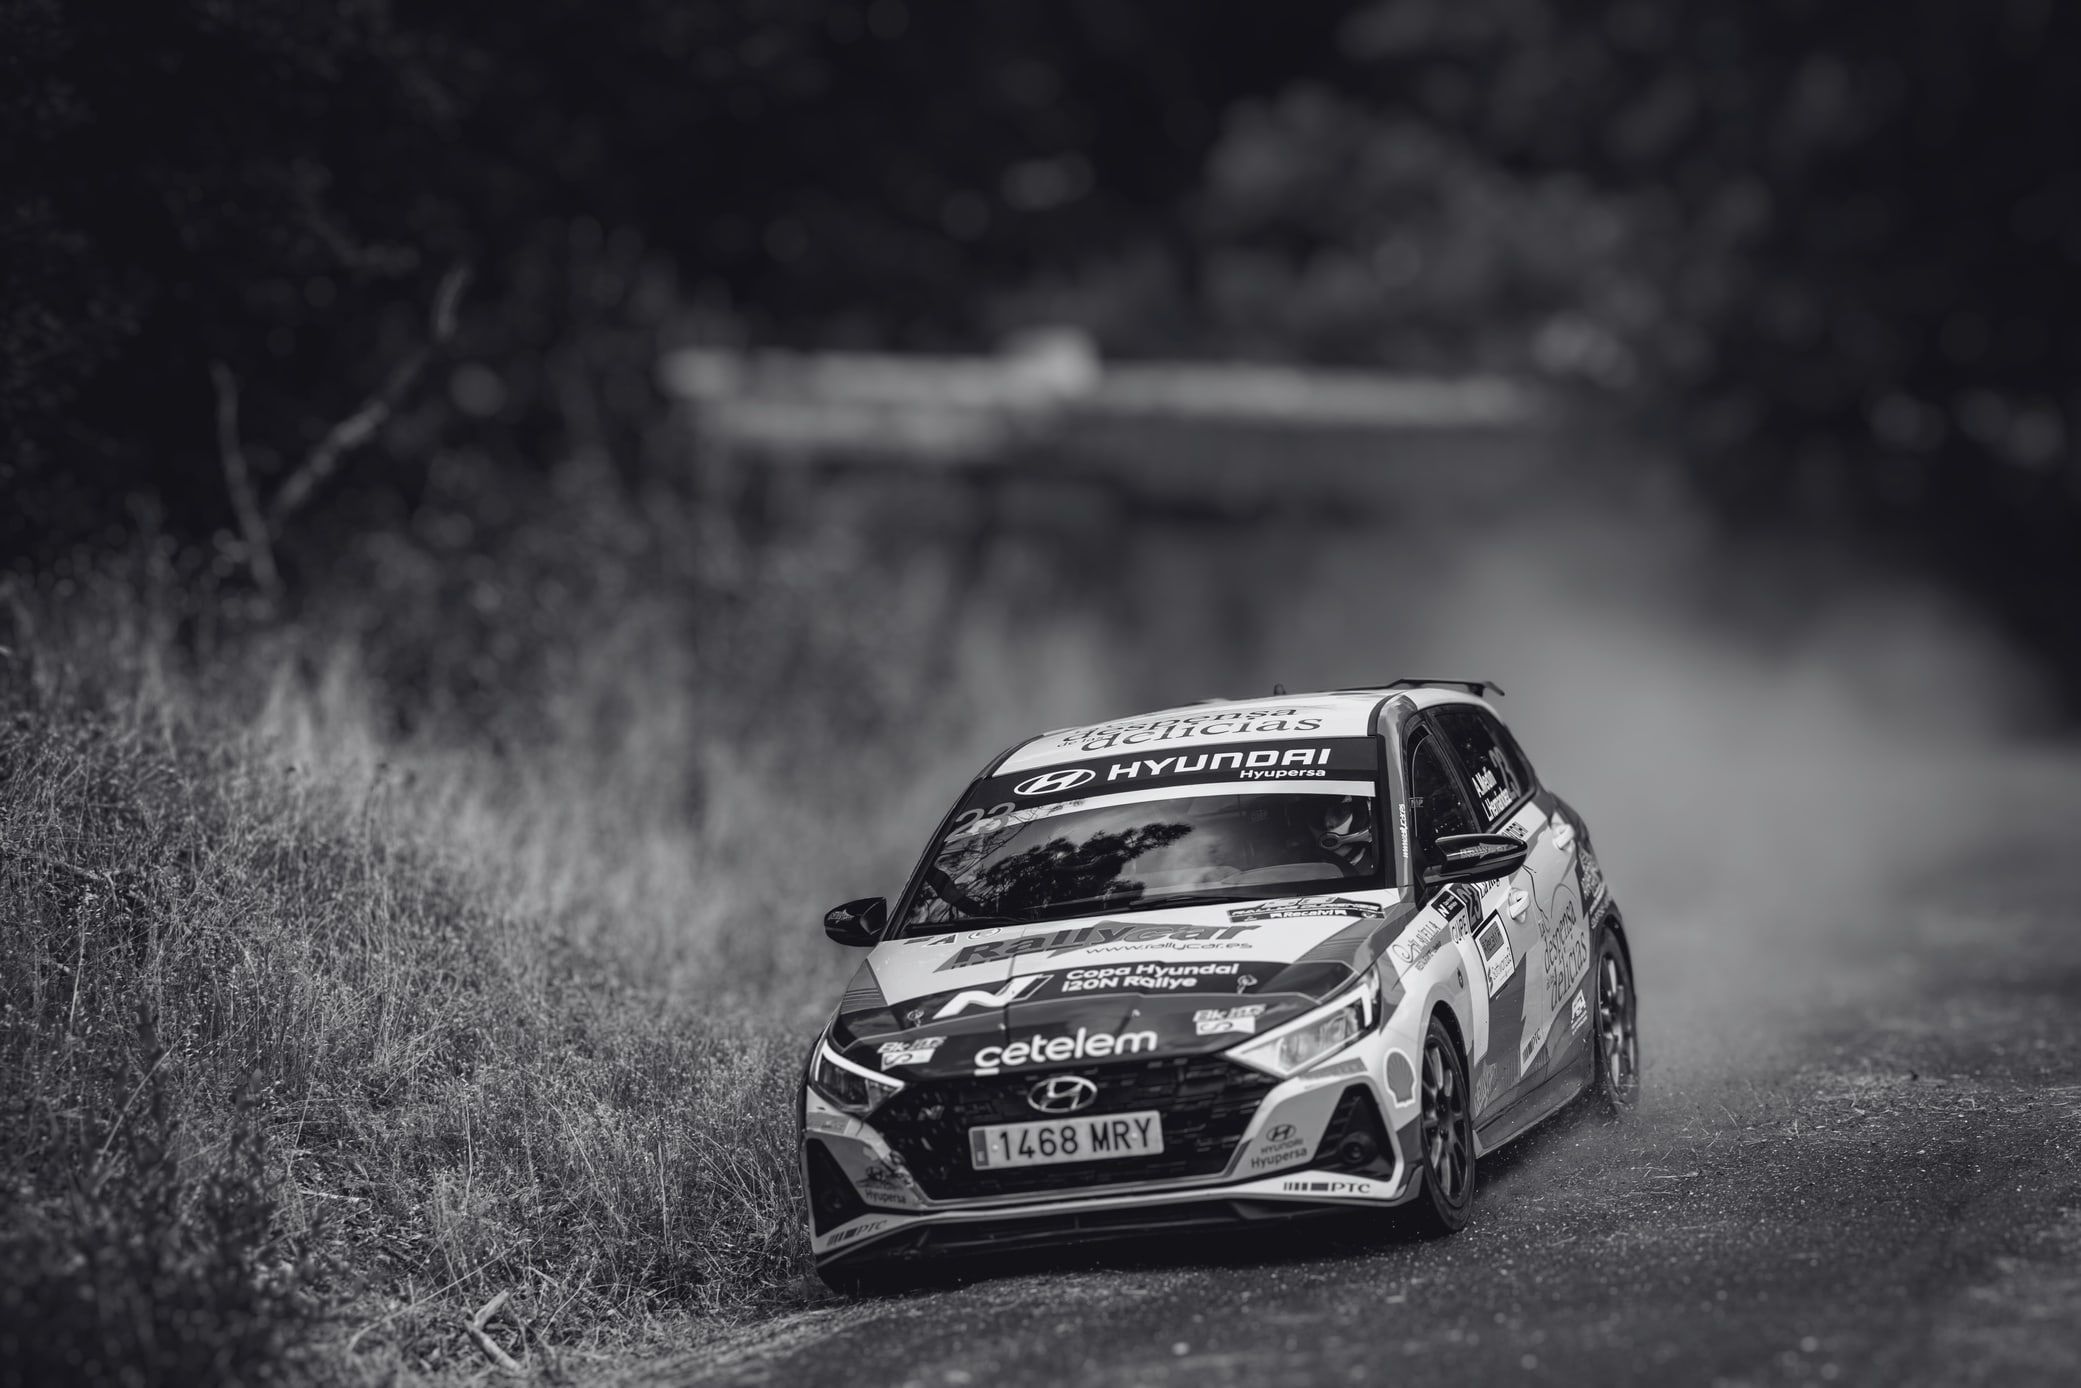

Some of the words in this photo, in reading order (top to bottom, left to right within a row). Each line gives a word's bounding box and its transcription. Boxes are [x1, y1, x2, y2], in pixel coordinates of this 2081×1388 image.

[1063, 707, 1298, 743] despensa
[1081, 717, 1324, 752] delicias
[1106, 748, 1332, 782] HYUNDAI
[1239, 768, 1327, 780] Hyupersa
[944, 801, 1016, 843] 23
[1283, 908, 1335, 919] Recalvi
[952, 925, 1262, 968] Rallycar
[1086, 941, 1254, 955] www.rallycar.es
[1544, 900, 1576, 974] despensa
[1062, 977, 1117, 992] i20N
[1123, 974, 1198, 989] Rallye
[1066, 966, 1127, 981] Copa
[1135, 963, 1239, 977] Hyundai
[1550, 931, 1587, 1012] delicias
[974, 1027, 1158, 1072] cetelem
[999, 1126, 1079, 1162] 1468
[1090, 1118, 1152, 1153] MRY
[1250, 1147, 1309, 1168] Hyupersa
[1331, 1182, 1371, 1194] PTC
